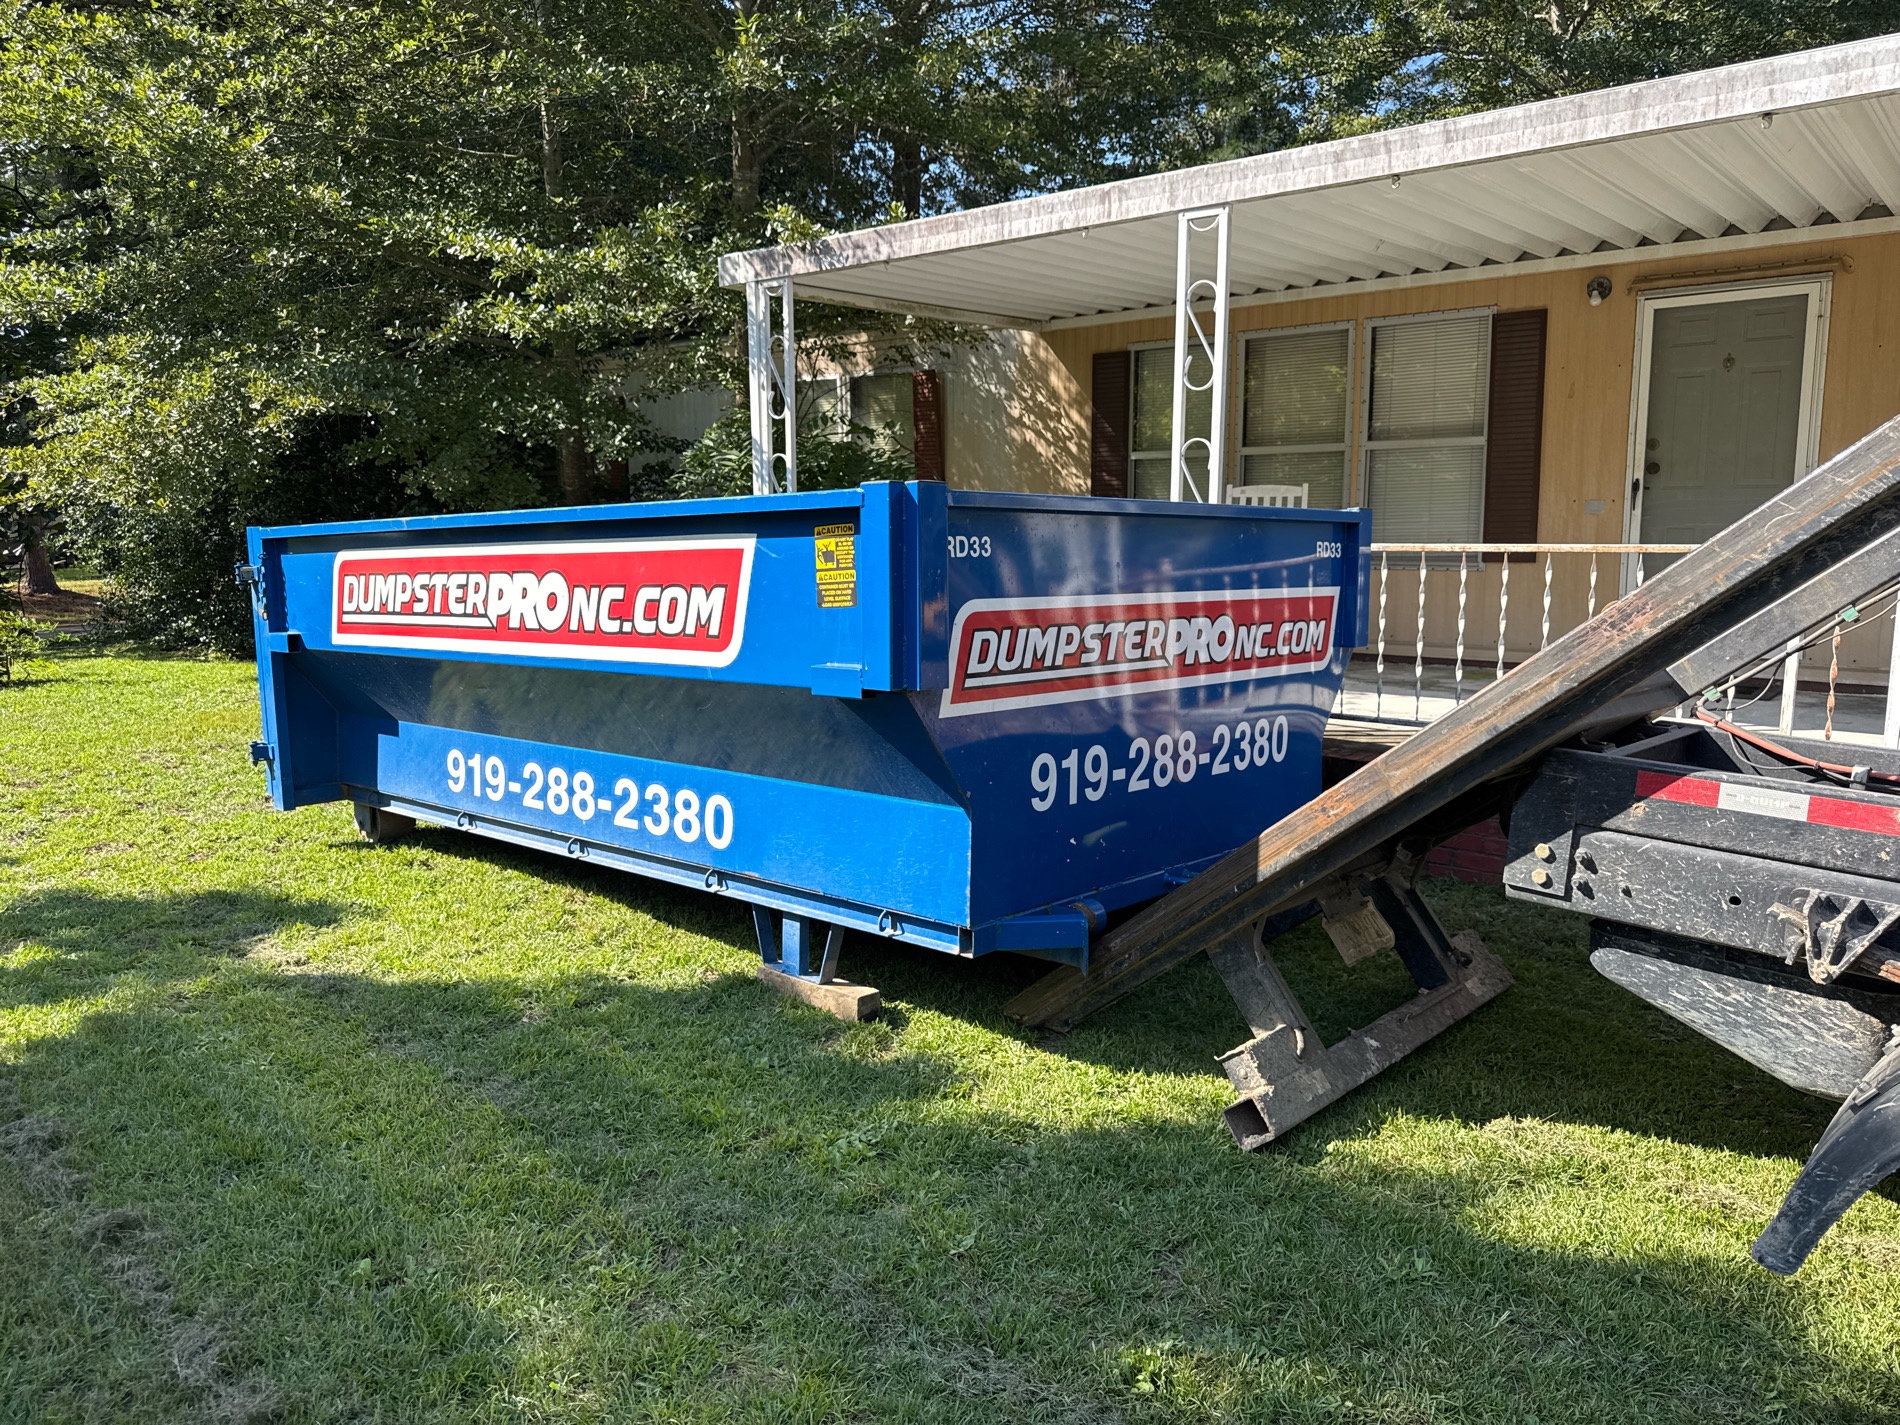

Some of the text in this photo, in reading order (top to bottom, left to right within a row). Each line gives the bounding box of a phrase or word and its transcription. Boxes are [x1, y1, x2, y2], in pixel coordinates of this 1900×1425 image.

[821, 525, 853, 535] CAUTION
[947, 535, 992, 558] RD33
[1316, 541, 1342, 558] RD33
[823, 572, 855, 582] CAUTION
[1030, 714, 1289, 812] 919-288-2380
[446, 748, 734, 850] 919-288-2380
